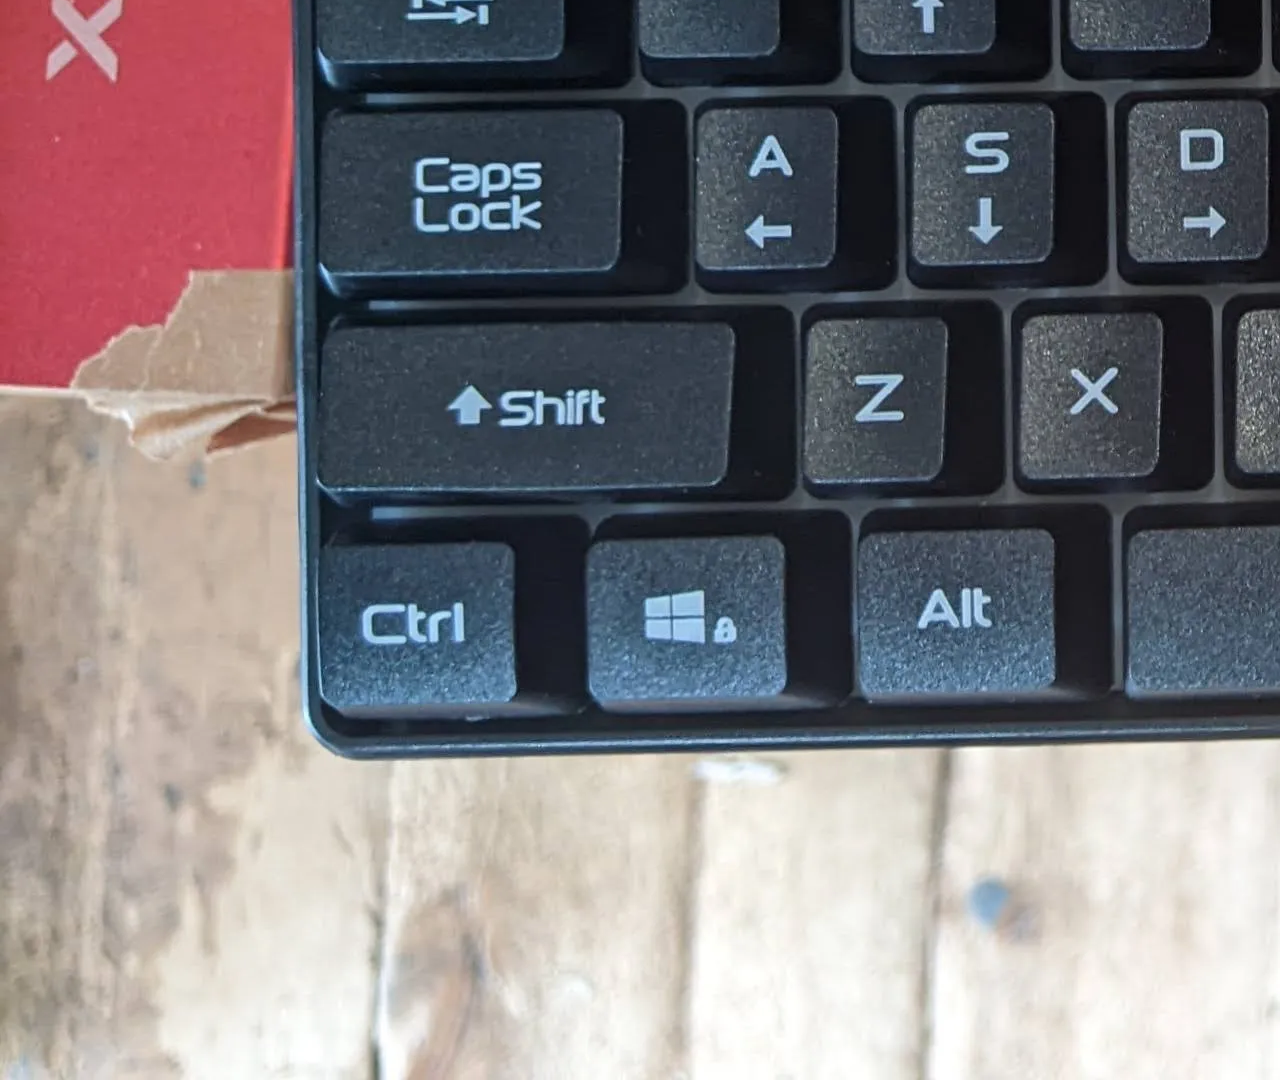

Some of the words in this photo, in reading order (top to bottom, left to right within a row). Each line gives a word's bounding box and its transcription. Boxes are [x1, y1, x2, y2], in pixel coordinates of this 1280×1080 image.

[748, 134, 793, 177] A
[964, 131, 1010, 174] S
[1179, 128, 1224, 171] D
[414, 157, 542, 198] Caps
[414, 194, 542, 233] Lock
[499, 389, 606, 427] Shift
[854, 374, 905, 422] Z
[1069, 367, 1119, 415] X
[361, 602, 465, 645] Ctrl
[917, 587, 992, 629] Alt
